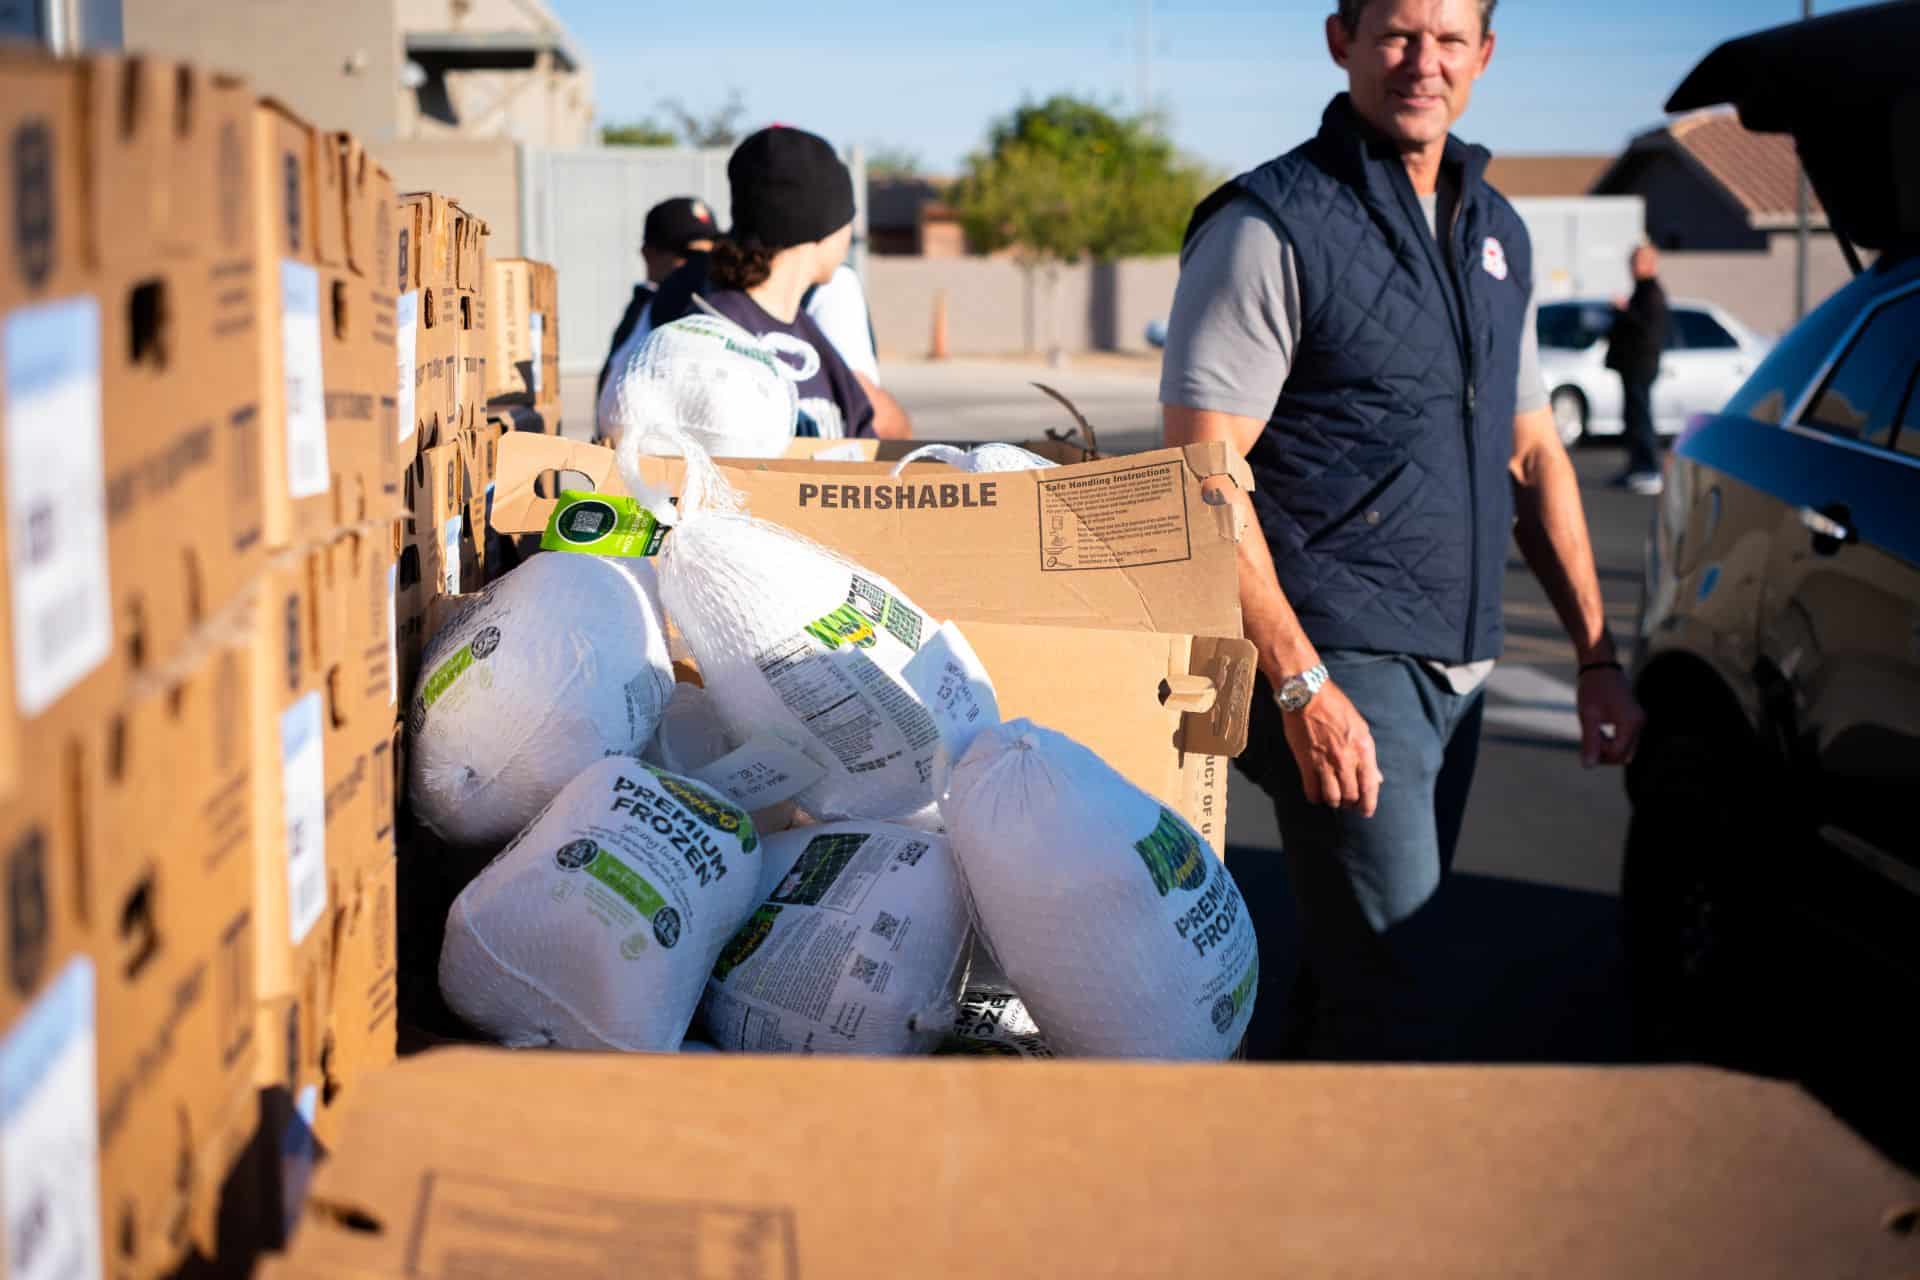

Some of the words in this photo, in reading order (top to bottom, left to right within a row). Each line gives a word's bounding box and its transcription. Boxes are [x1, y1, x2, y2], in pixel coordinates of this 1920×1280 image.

[1045, 483, 1067, 492] Safe
[1069, 476, 1111, 489] Handling
[1113, 467, 1171, 483] Instructions
[798, 482, 998, 510] PERISHABLE
[1202, 795, 1213, 817] OF
[610, 796, 712, 888] FROZEN
[612, 775, 728, 882] PREMIUM
